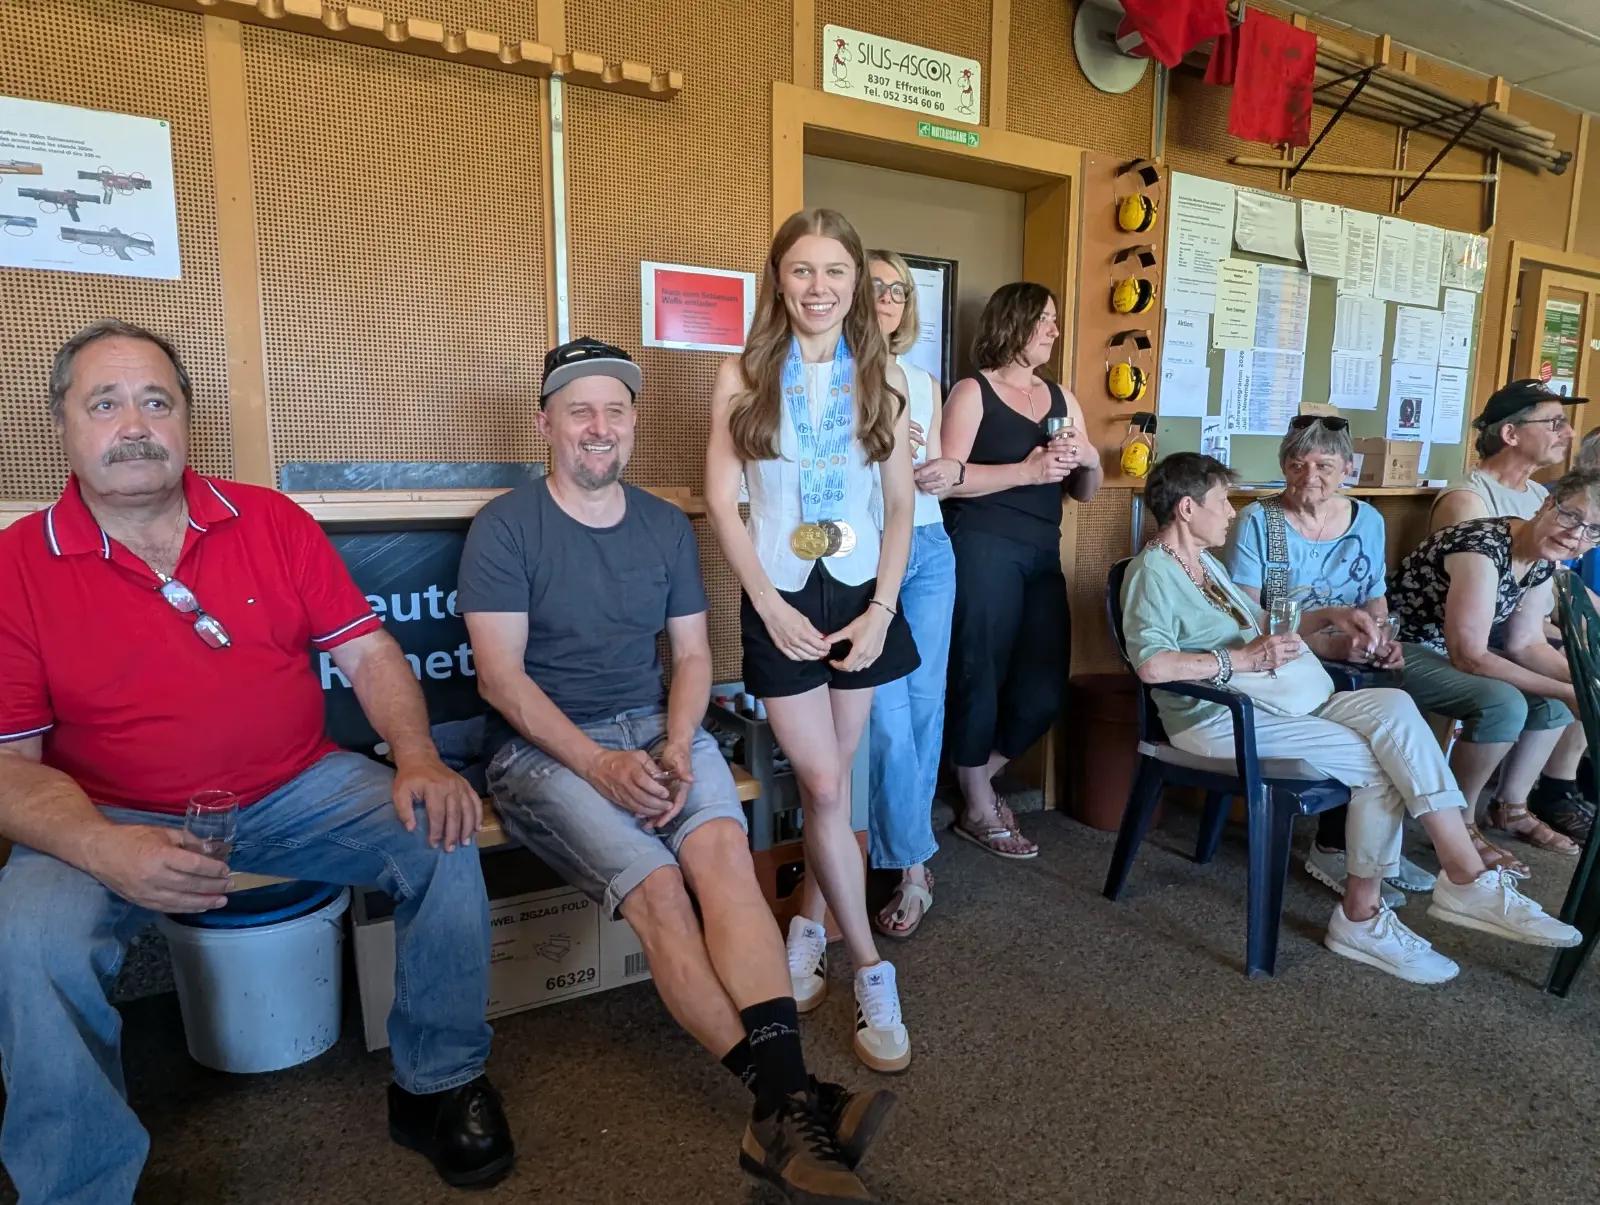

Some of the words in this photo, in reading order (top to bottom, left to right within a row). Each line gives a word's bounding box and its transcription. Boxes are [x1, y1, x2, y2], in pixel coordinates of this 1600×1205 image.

[857, 42, 952, 85] SIUS-ASCOR
[867, 73, 890, 87] 8307
[895, 80, 942, 98] Effretikon
[864, 85, 881, 98] Tel.
[883, 90, 900, 102] 052
[902, 94, 919, 106] 354
[921, 98, 932, 109] 60
[934, 102, 945, 112] 60
[519, 906, 559, 922] ZIGZAG
[561, 899, 589, 913] FOLD
[545, 967, 596, 991] 66329
